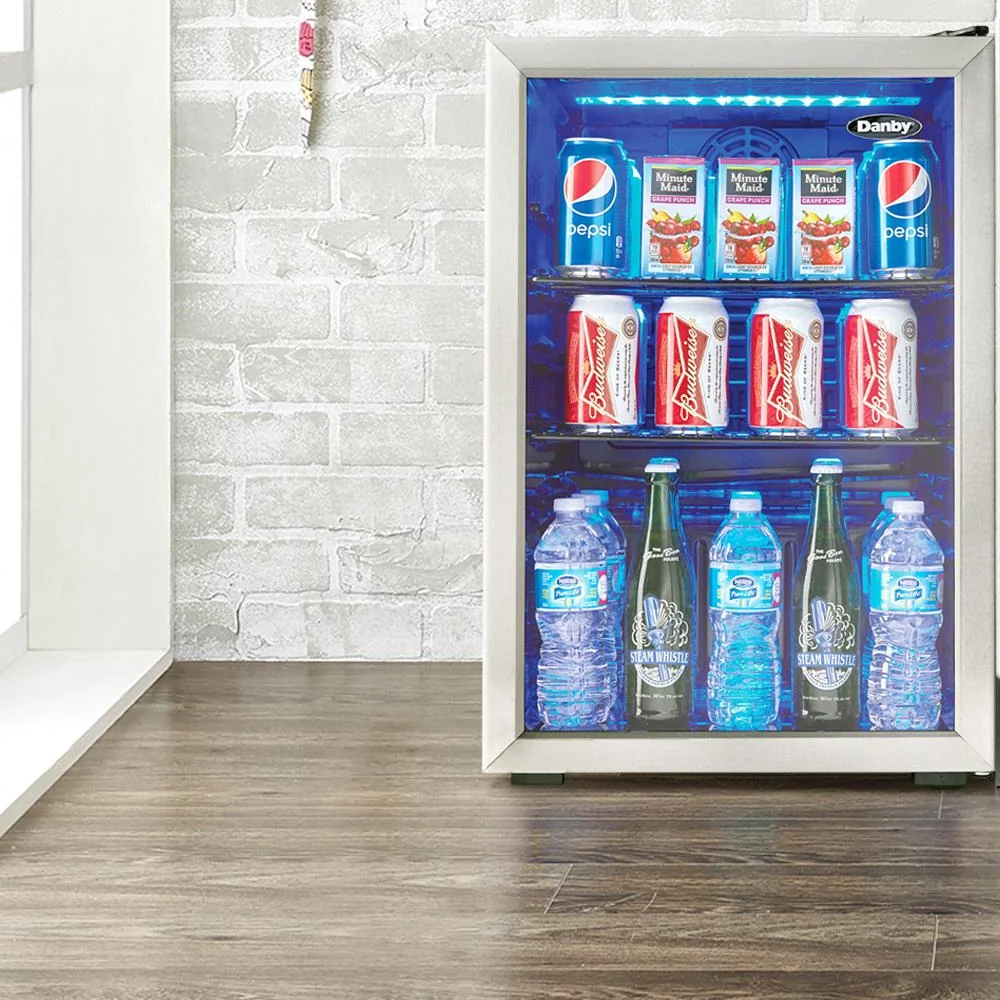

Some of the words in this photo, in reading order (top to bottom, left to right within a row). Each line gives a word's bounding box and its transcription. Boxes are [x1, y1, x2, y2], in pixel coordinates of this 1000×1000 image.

[857, 120, 912, 135] Danby
[655, 172, 693, 183] Minute
[730, 173, 768, 183] Minute
[805, 174, 842, 184] Minute
[660, 183, 689, 192] Maid
[735, 183, 763, 193] Maid
[810, 184, 838, 193] Maid
[567, 222, 611, 239] pepsi
[884, 223, 928, 241] pepsi
[630, 651, 654, 664] STEAM
[655, 651, 689, 664] WHISTLE
[797, 654, 821, 665] STEAM
[823, 654, 856, 666] WHISTLE
